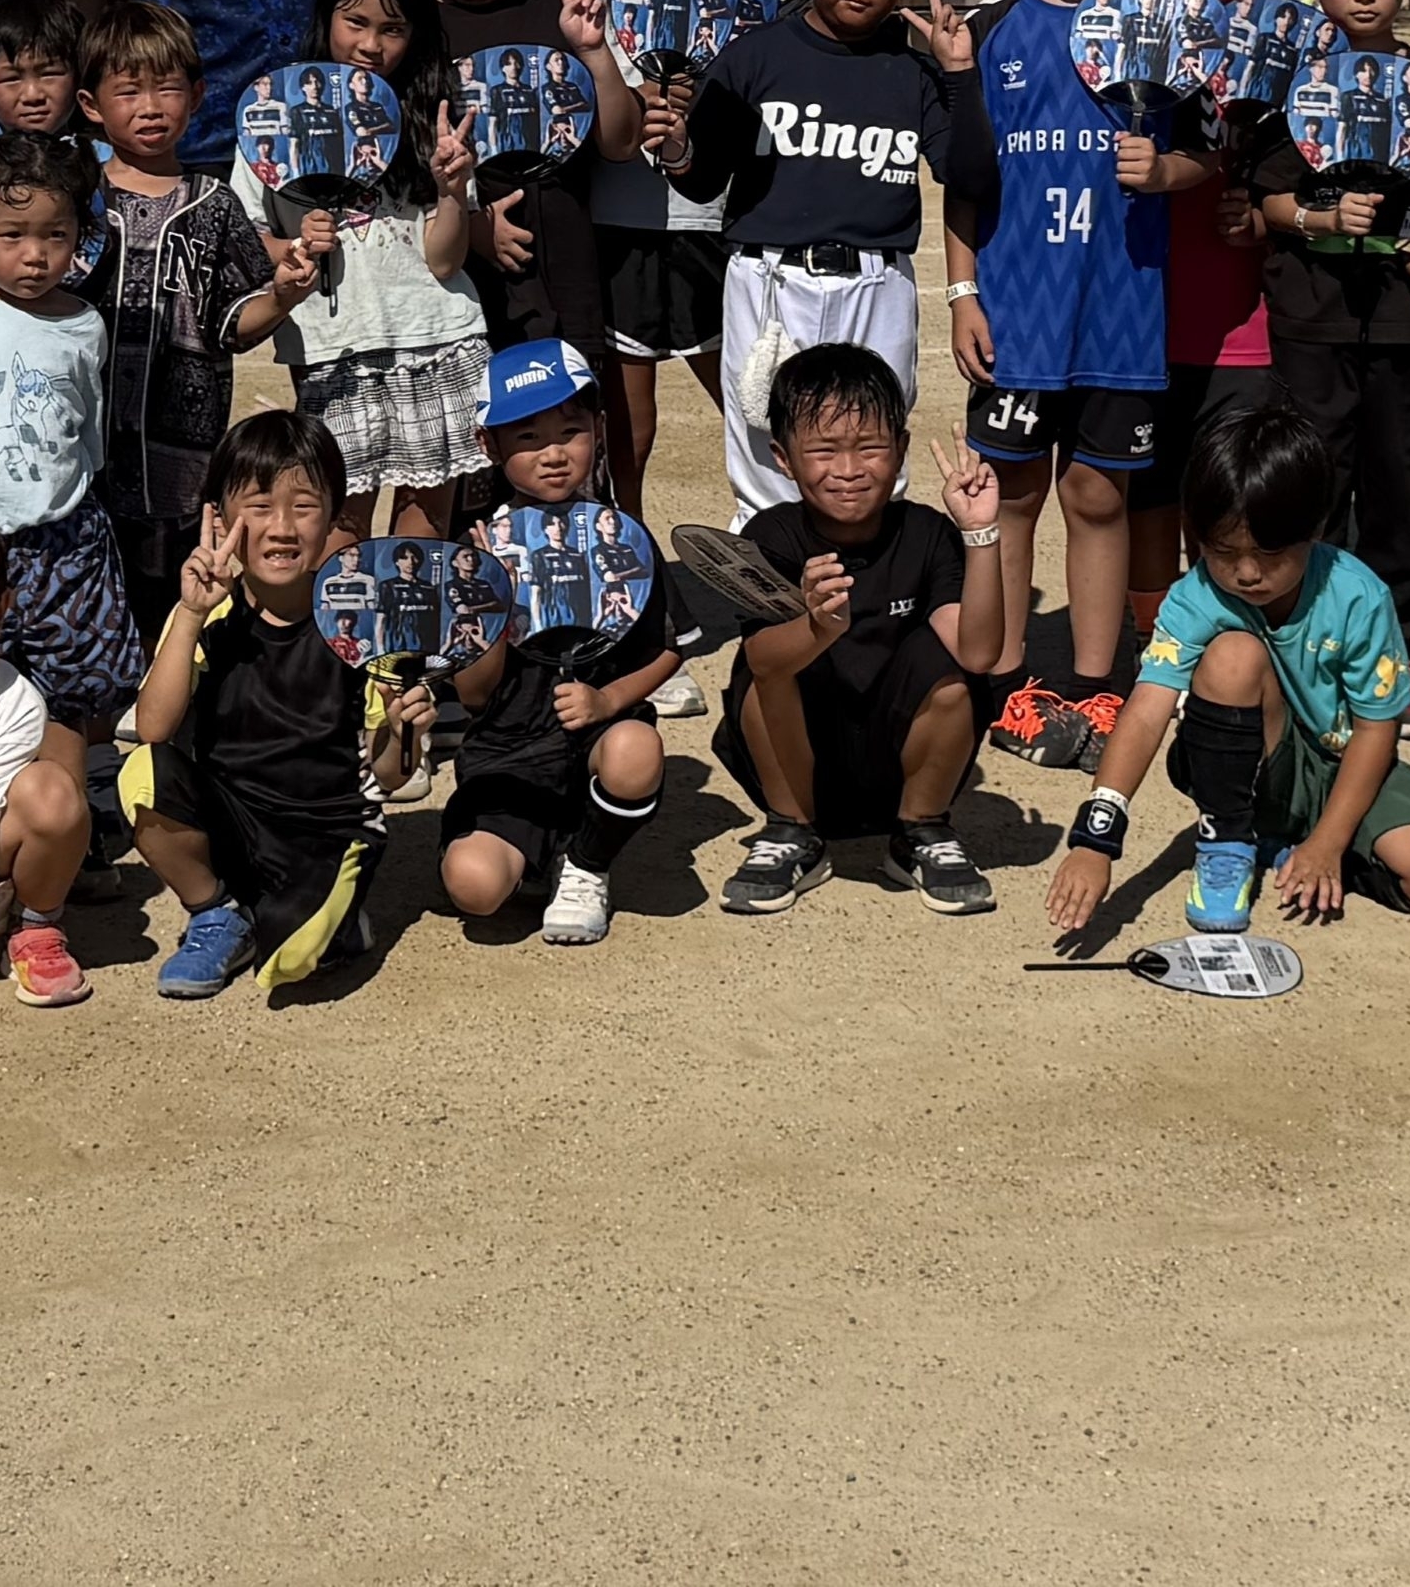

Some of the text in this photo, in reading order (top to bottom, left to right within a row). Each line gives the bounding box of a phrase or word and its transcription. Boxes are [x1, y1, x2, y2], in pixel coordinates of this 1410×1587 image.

[755, 101, 920, 177] Rings
[998, 129, 1066, 156] AMBA
[1046, 187, 1092, 244] 34
[505, 369, 548, 394] PUMA
